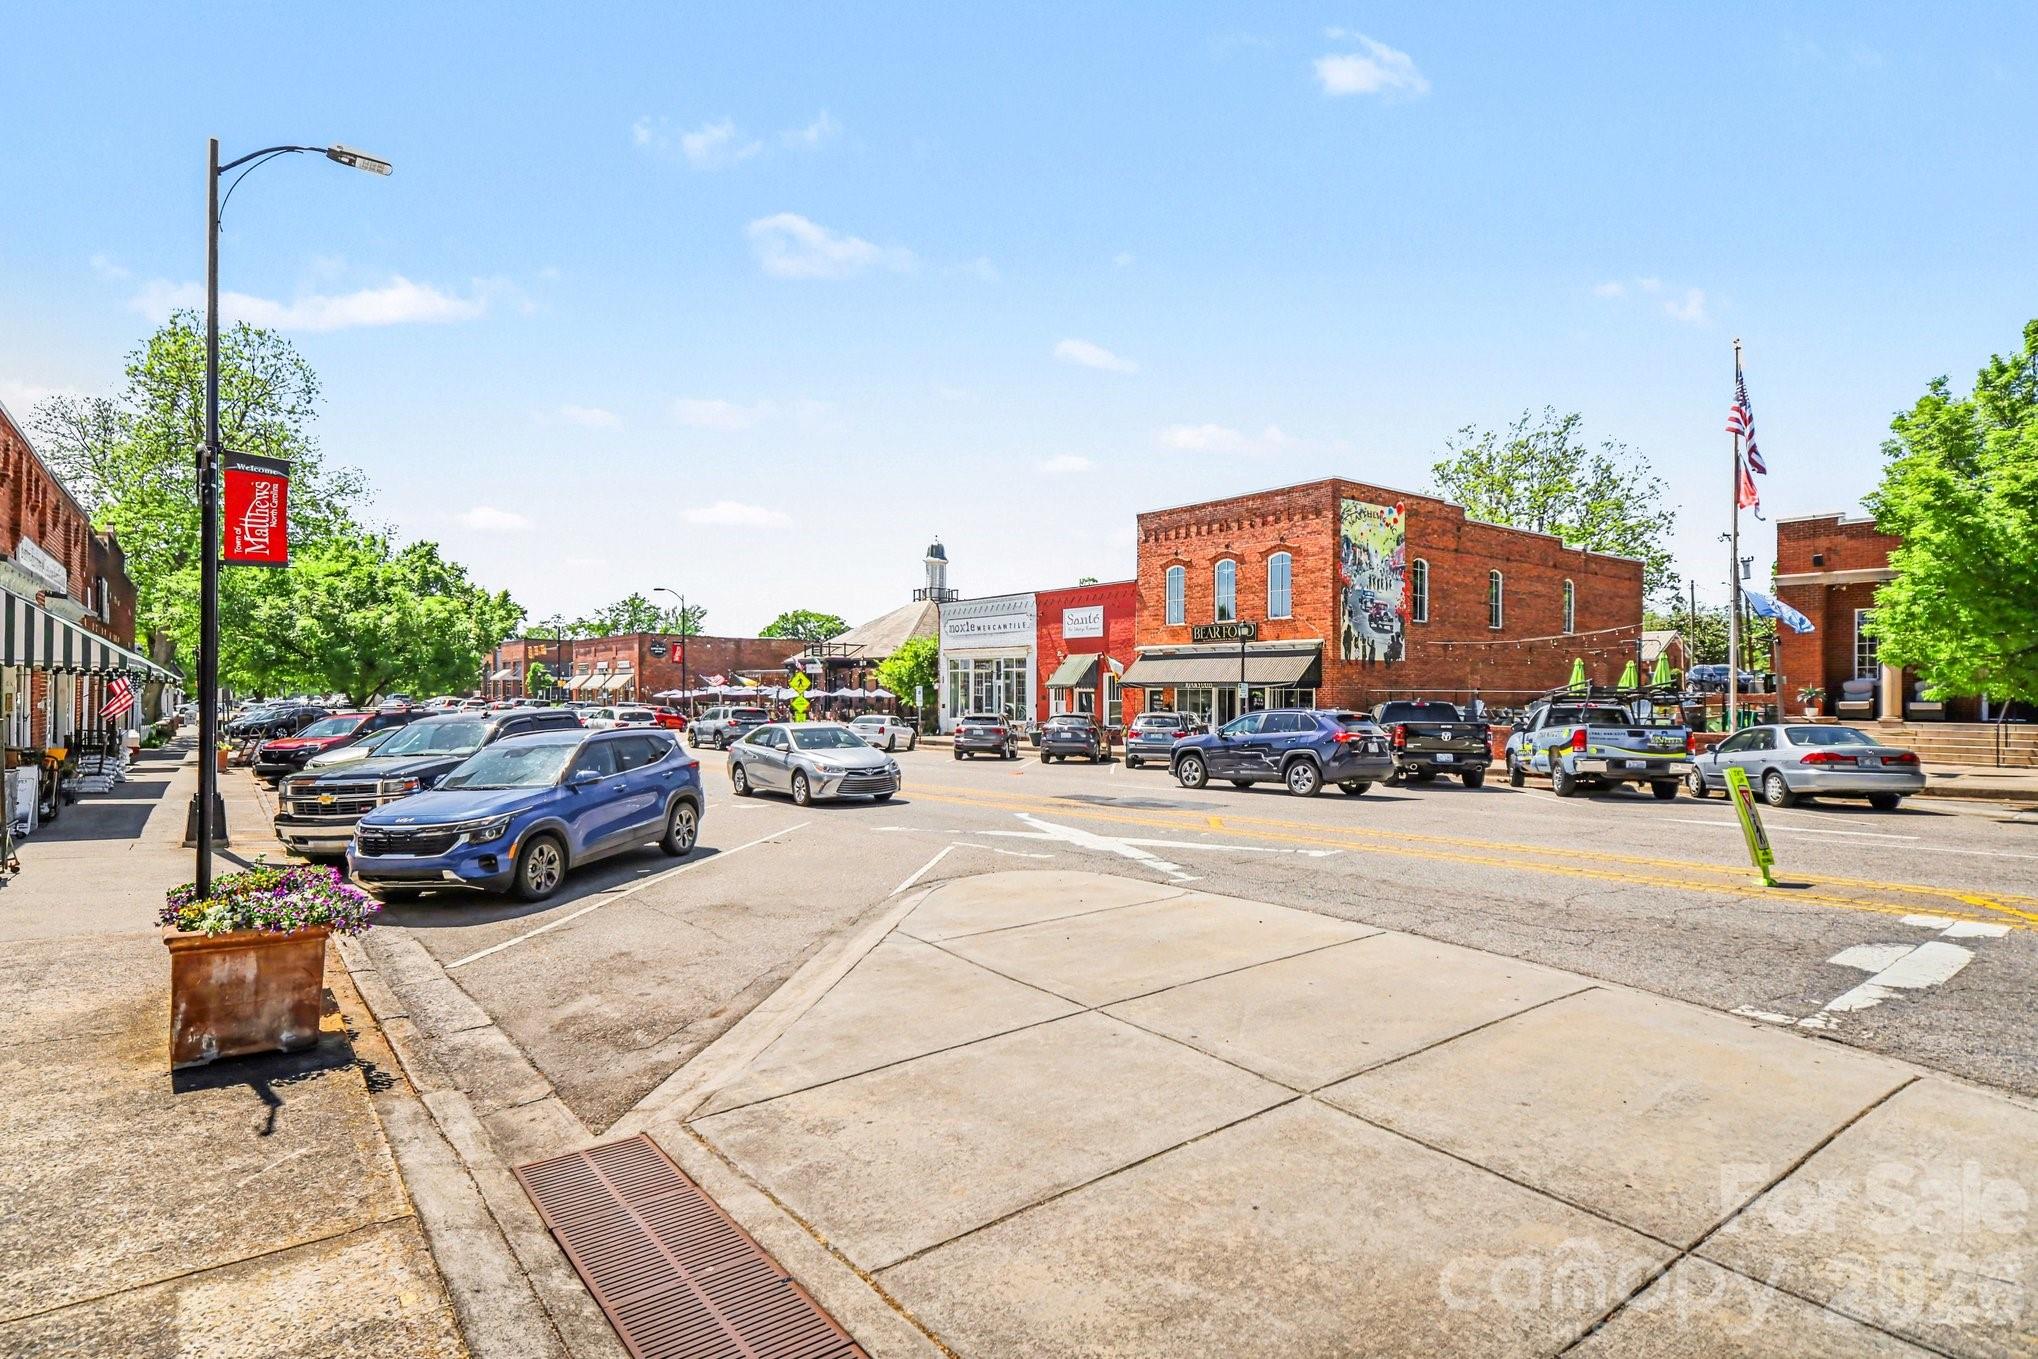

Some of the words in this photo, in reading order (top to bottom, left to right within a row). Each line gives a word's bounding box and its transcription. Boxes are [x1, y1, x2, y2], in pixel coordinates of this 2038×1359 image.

[236, 463, 280, 475] Welcome
[270, 483, 279, 509] Carolina
[240, 481, 271, 556] Matthews
[270, 510, 279, 528] North
[234, 536, 243, 554] Town
[977, 621, 1027, 632] MERCANTILE
